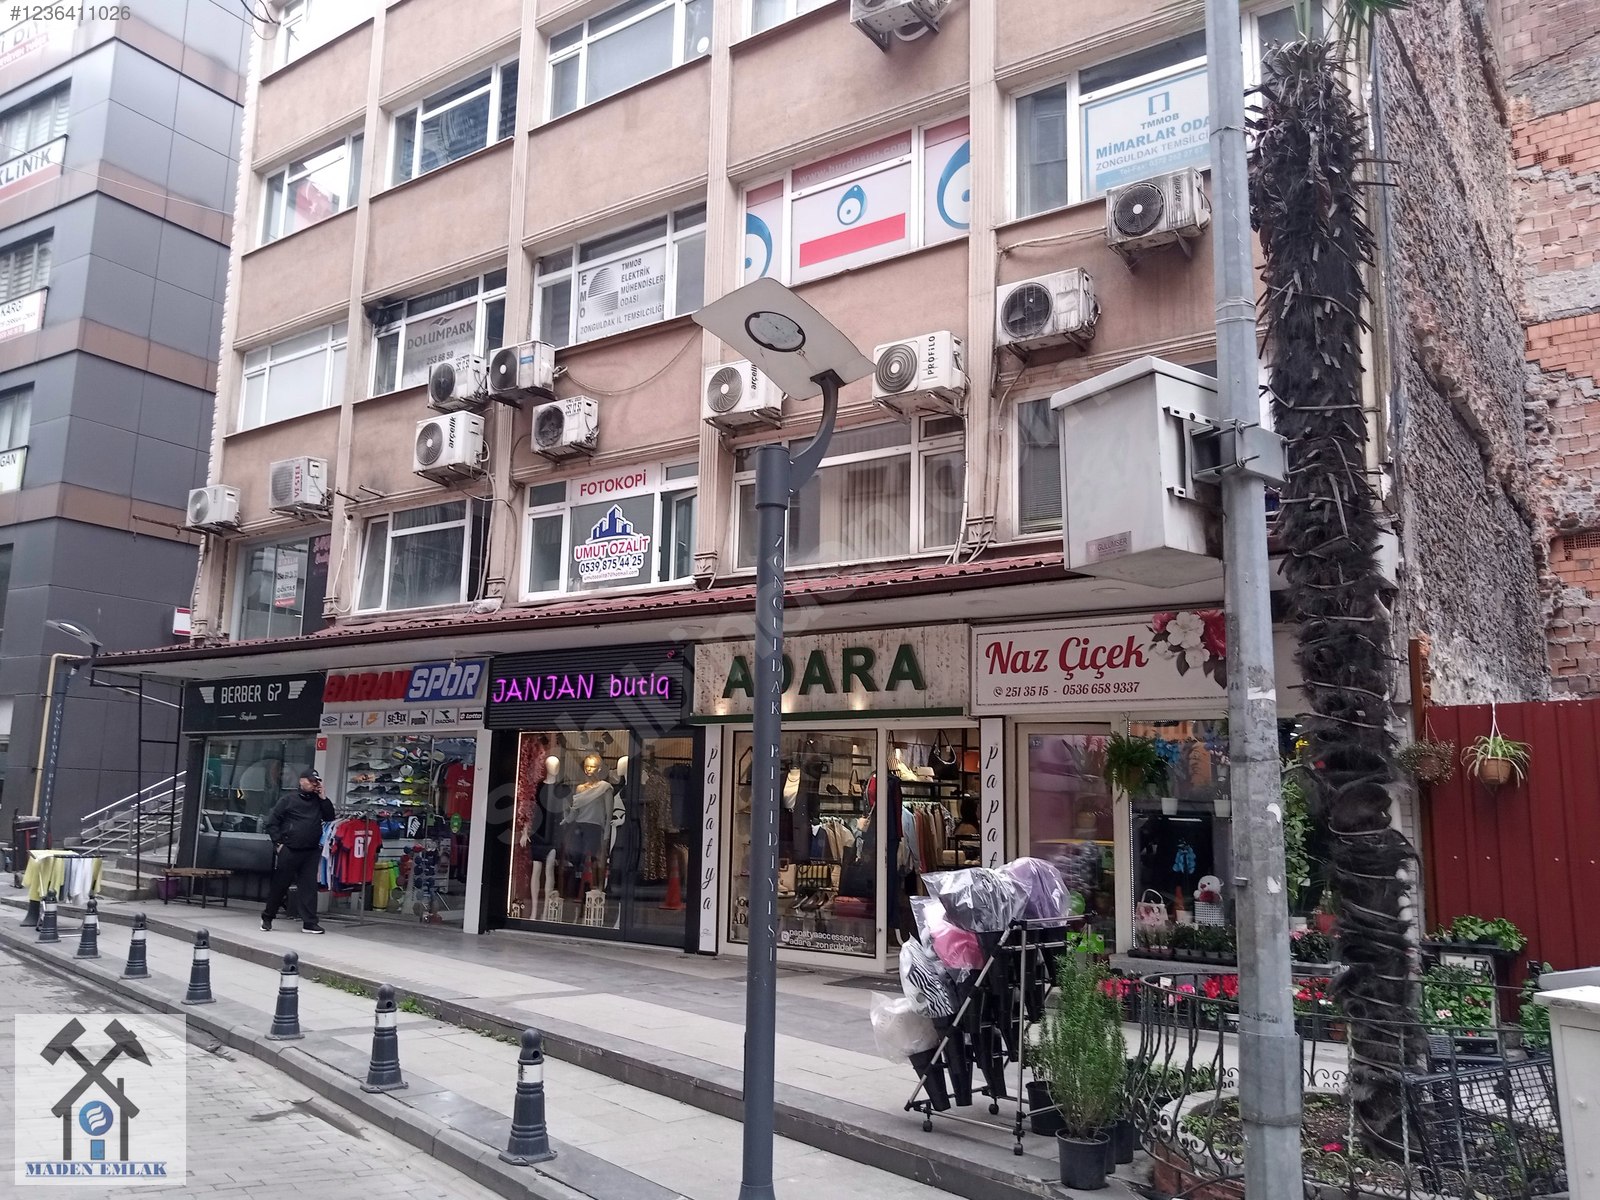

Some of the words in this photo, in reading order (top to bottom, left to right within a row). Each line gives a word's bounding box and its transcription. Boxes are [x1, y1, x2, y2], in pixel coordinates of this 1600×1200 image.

[1140, 112, 1180, 130] TMMOB
[1096, 126, 1176, 159] MİMARLAR
[1096, 146, 1158, 171] ZONGULDAK
[621, 258, 642, 271] TMMOB
[621, 265, 650, 283] ELEKTRİK
[619, 294, 639, 308] ODASI
[407, 320, 474, 350] DOLUMPARK
[580, 318, 615, 335] ZONGULDAK
[580, 469, 647, 497] FOTOKOPİ
[575, 544, 607, 560] UMUT
[609, 535, 649, 555] OZALİT
[580, 561, 600, 574] 0539
[602, 559, 617, 571] 875
[619, 557, 630, 567] 44
[632, 555, 642, 566] 25
[985, 640, 1049, 675] Naz
[1058, 635, 1149, 681] Çiçek
[221, 684, 262, 704] BERBER
[267, 683, 282, 702] 67
[322, 669, 414, 703] BARAN
[408, 663, 481, 699] SPOR
[492, 673, 594, 703] JANJAN
[609, 672, 669, 700] butiq
[1005, 686, 1021, 698] 251
[1023, 685, 1036, 697] 35
[1038, 685, 1049, 696] 15
[1062, 684, 1089, 696] 0536
[1091, 683, 1111, 695] 658
[1113, 681, 1140, 694] 9337
[409, 817, 421, 837] NIKE
[701, 746, 719, 910] papatya
